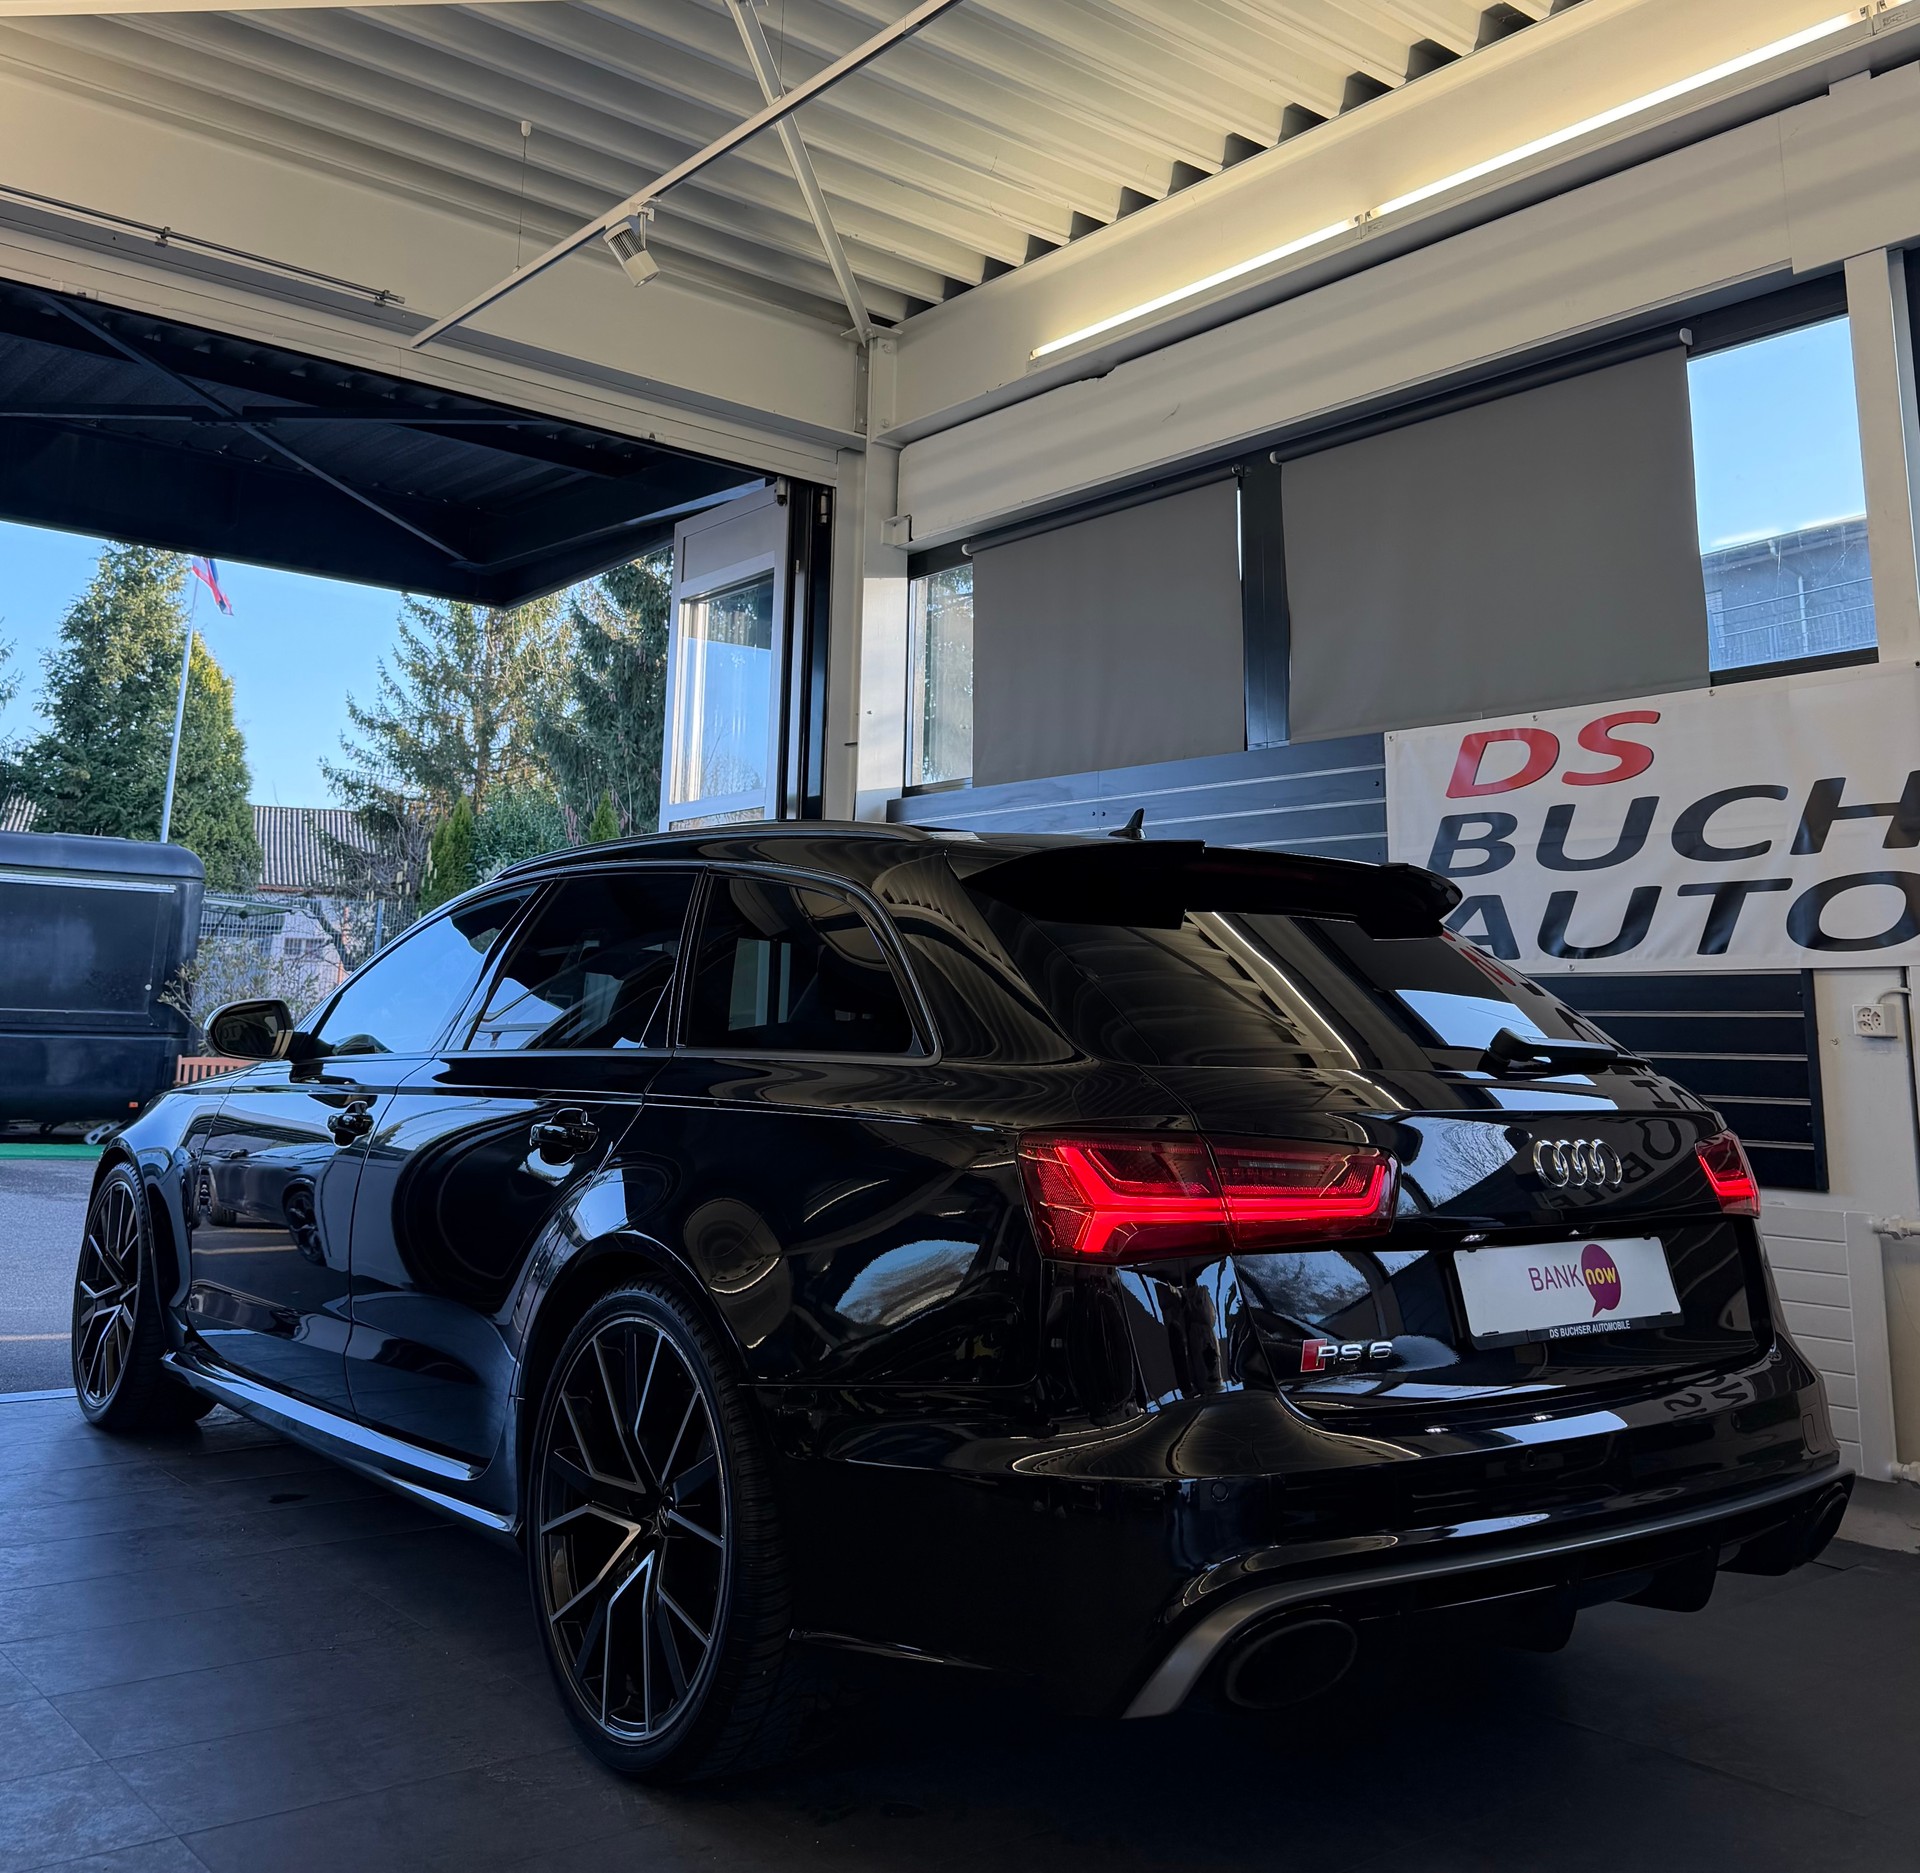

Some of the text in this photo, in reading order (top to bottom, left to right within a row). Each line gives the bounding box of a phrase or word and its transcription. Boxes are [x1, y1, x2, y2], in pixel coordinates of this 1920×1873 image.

[1446, 710, 1661, 799] DS
[1444, 870, 1920, 961] AUTO
[1528, 1264, 1617, 1292] BANK now
[1549, 1320, 1631, 1339] DS BUCHSER AUTOMOBILE
